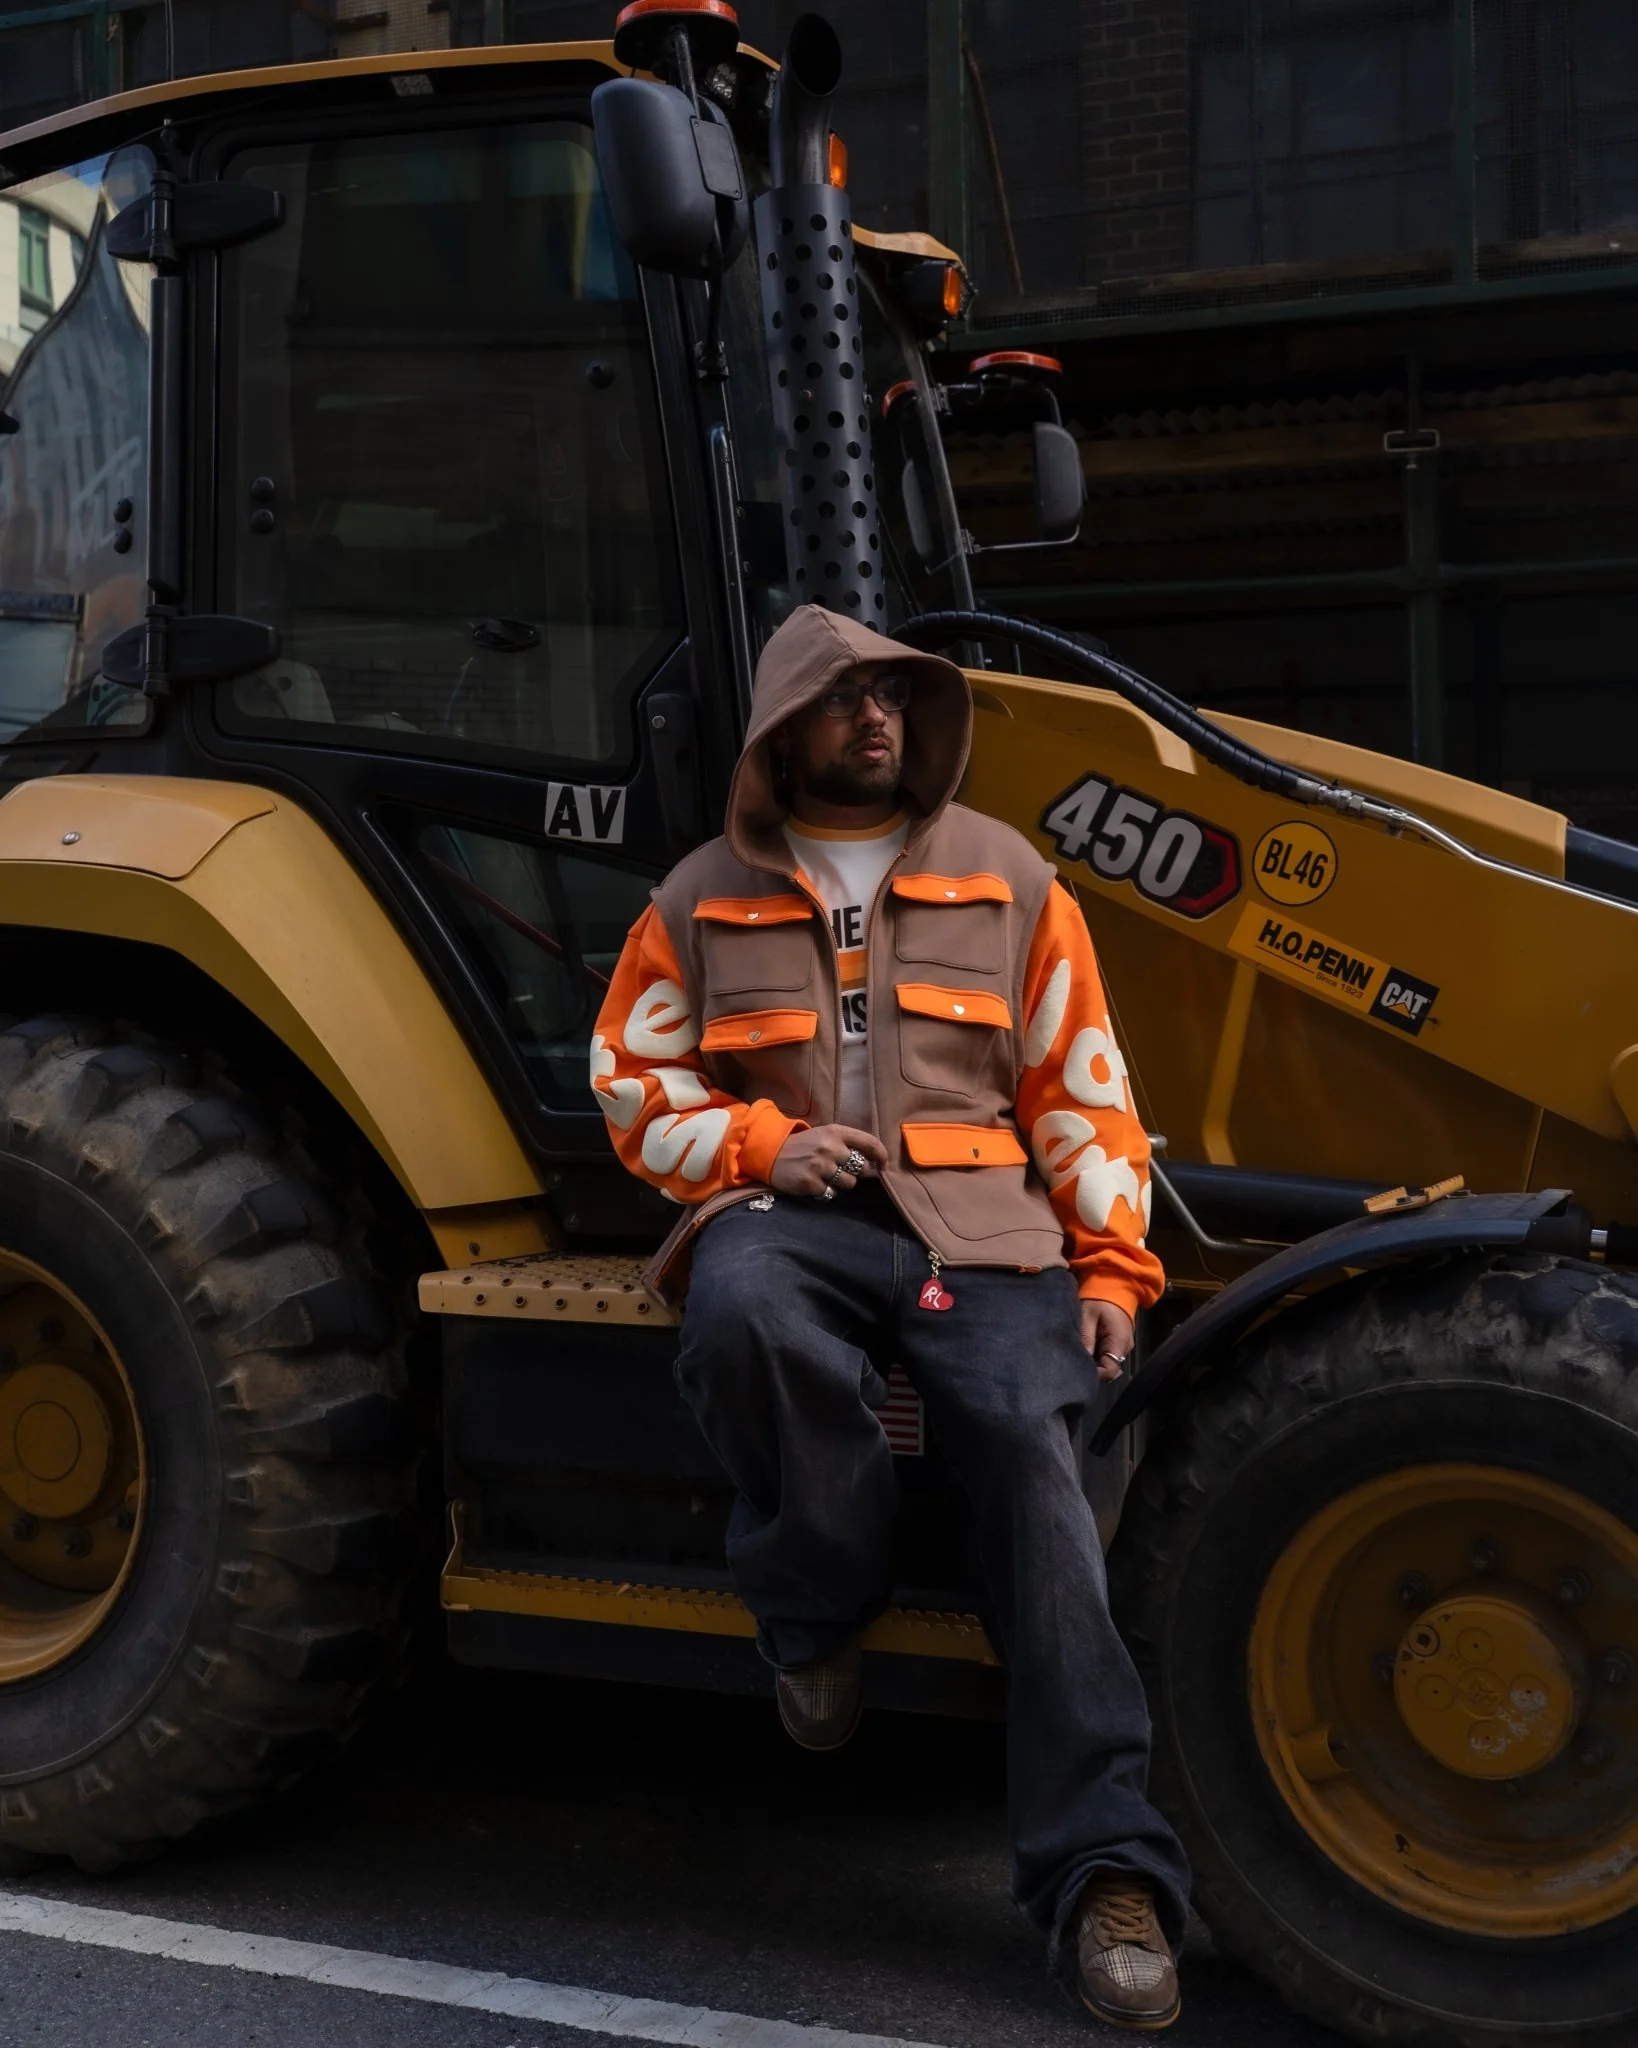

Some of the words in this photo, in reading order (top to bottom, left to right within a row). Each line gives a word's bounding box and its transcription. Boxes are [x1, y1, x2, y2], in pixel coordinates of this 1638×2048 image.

[549, 785, 622, 839] AV
[1045, 779, 1203, 898] 450
[1261, 838, 1329, 889] BL46
[1258, 919, 1375, 990] H.O.PENN
[1316, 972, 1338, 987] Since
[1341, 983, 1364, 999] 1923
[1380, 982, 1429, 1020] CAT
